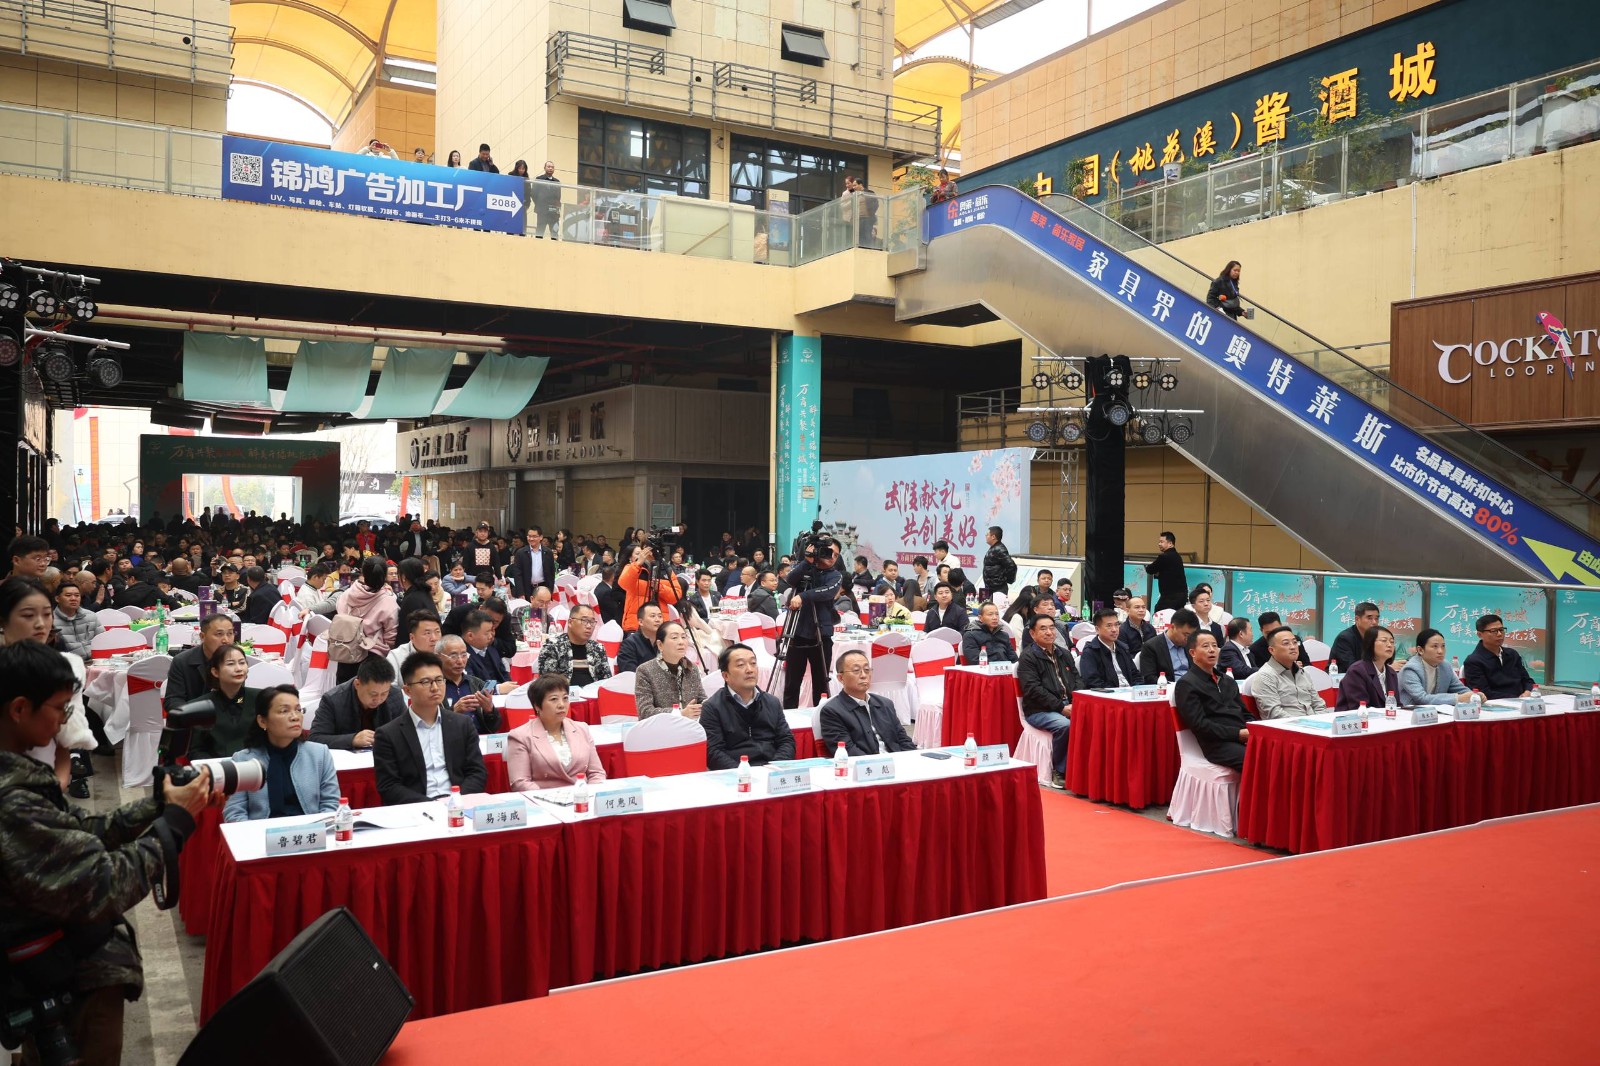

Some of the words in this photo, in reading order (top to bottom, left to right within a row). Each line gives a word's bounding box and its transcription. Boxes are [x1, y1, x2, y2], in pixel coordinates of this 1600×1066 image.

[271, 158, 483, 211] 锦鸿广告加工厂
[491, 198, 517, 208] 2088
[1086, 250, 1391, 455] 家具界的奥特莱斯
[1432, 329, 1600, 384] COCKAT
[566, 444, 604, 460] FLOOR
[885, 479, 961, 516] 武陵献礼
[1415, 445, 1514, 515] 名品家具折扣中心
[901, 511, 977, 550] 共创美好
[278, 832, 318, 848] 鲁碧君
